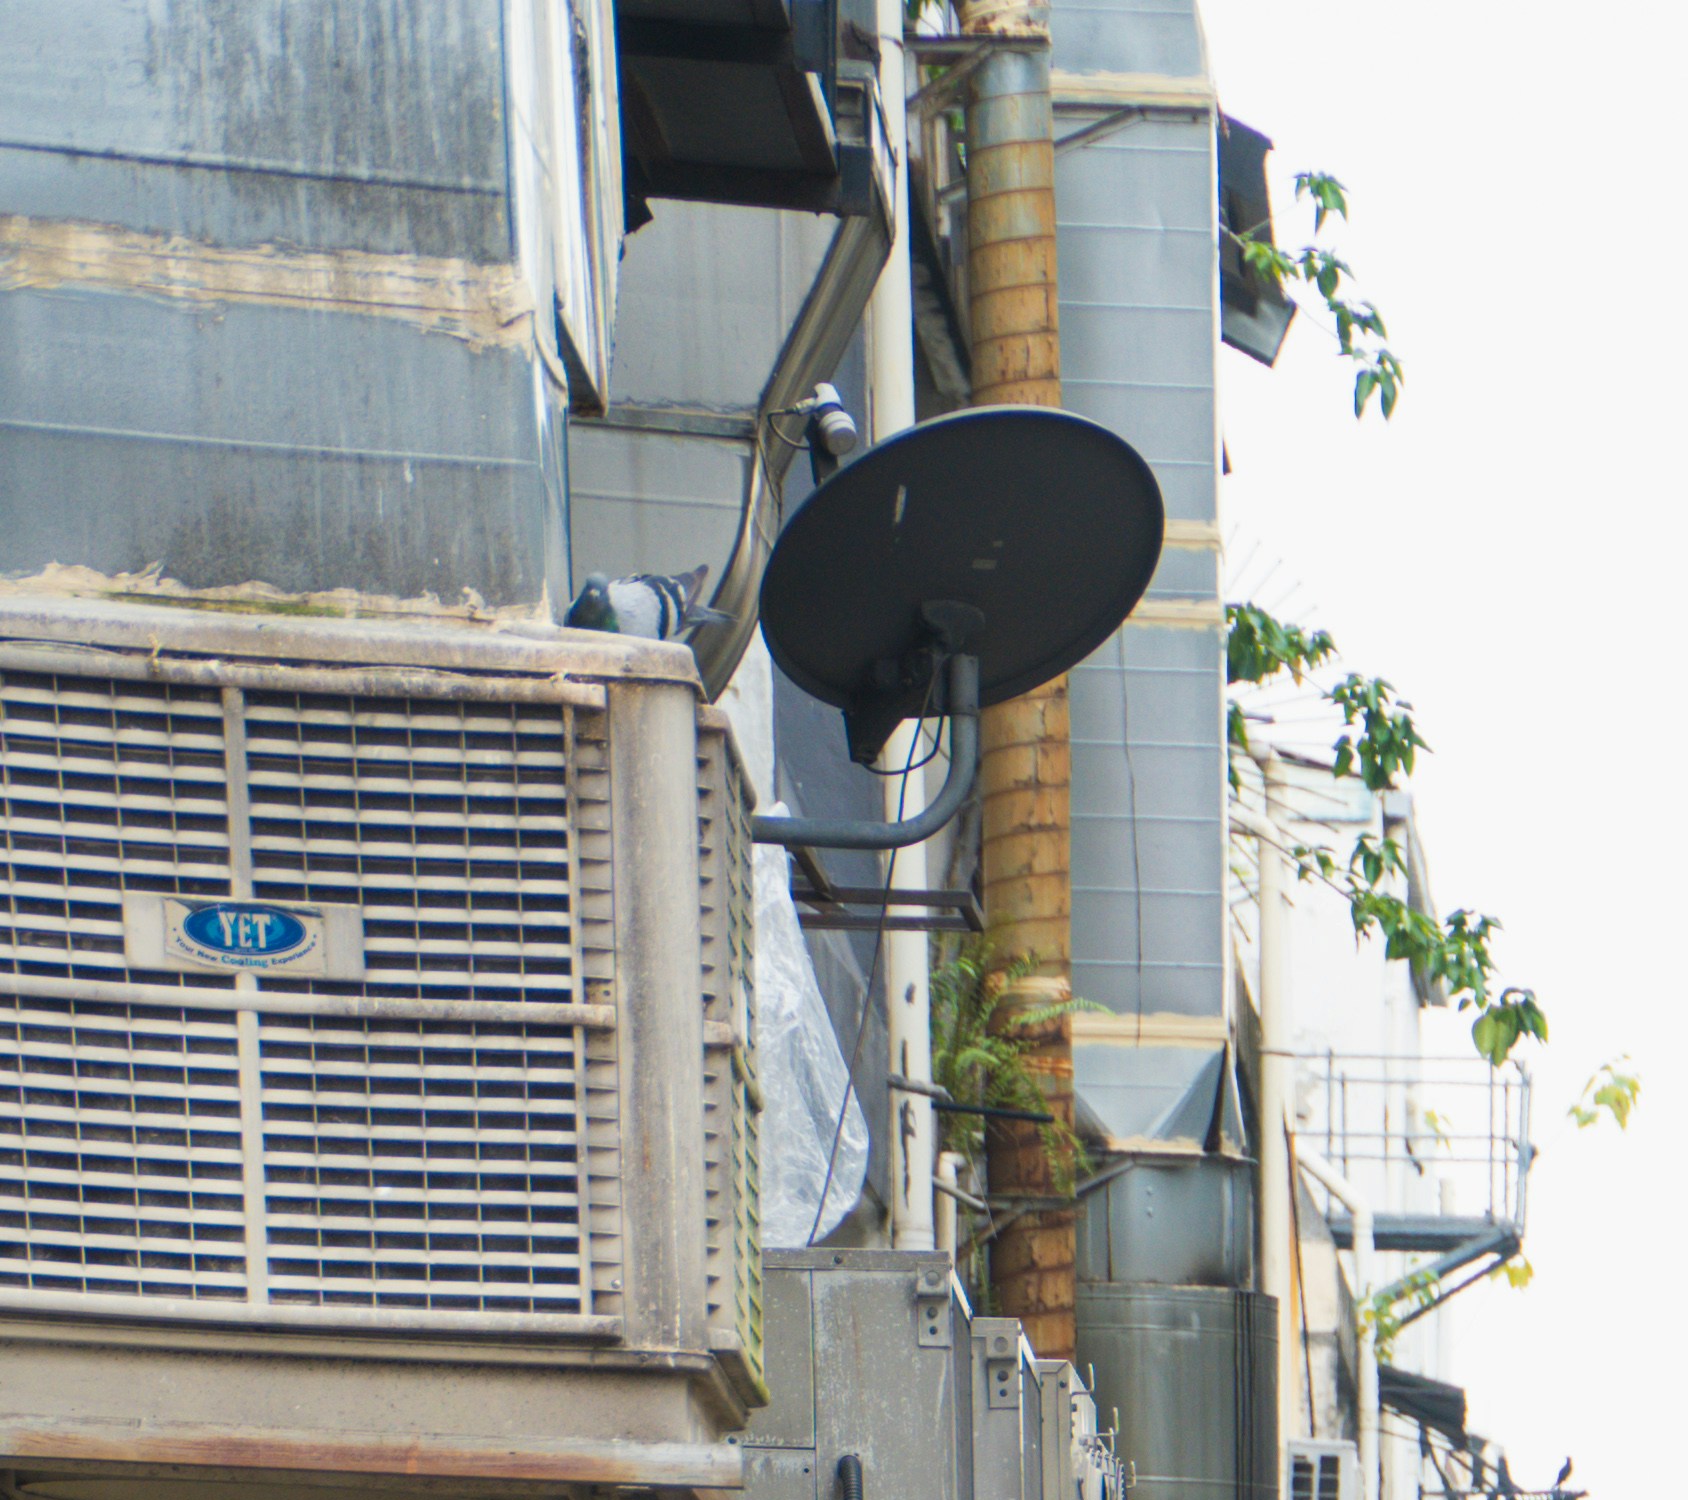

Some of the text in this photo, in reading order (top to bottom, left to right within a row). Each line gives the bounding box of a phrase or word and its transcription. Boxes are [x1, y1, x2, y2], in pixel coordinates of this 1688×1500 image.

[218, 911, 271, 949] YET
[221, 955, 268, 969] Cooling
[271, 940, 316, 966] Experience
